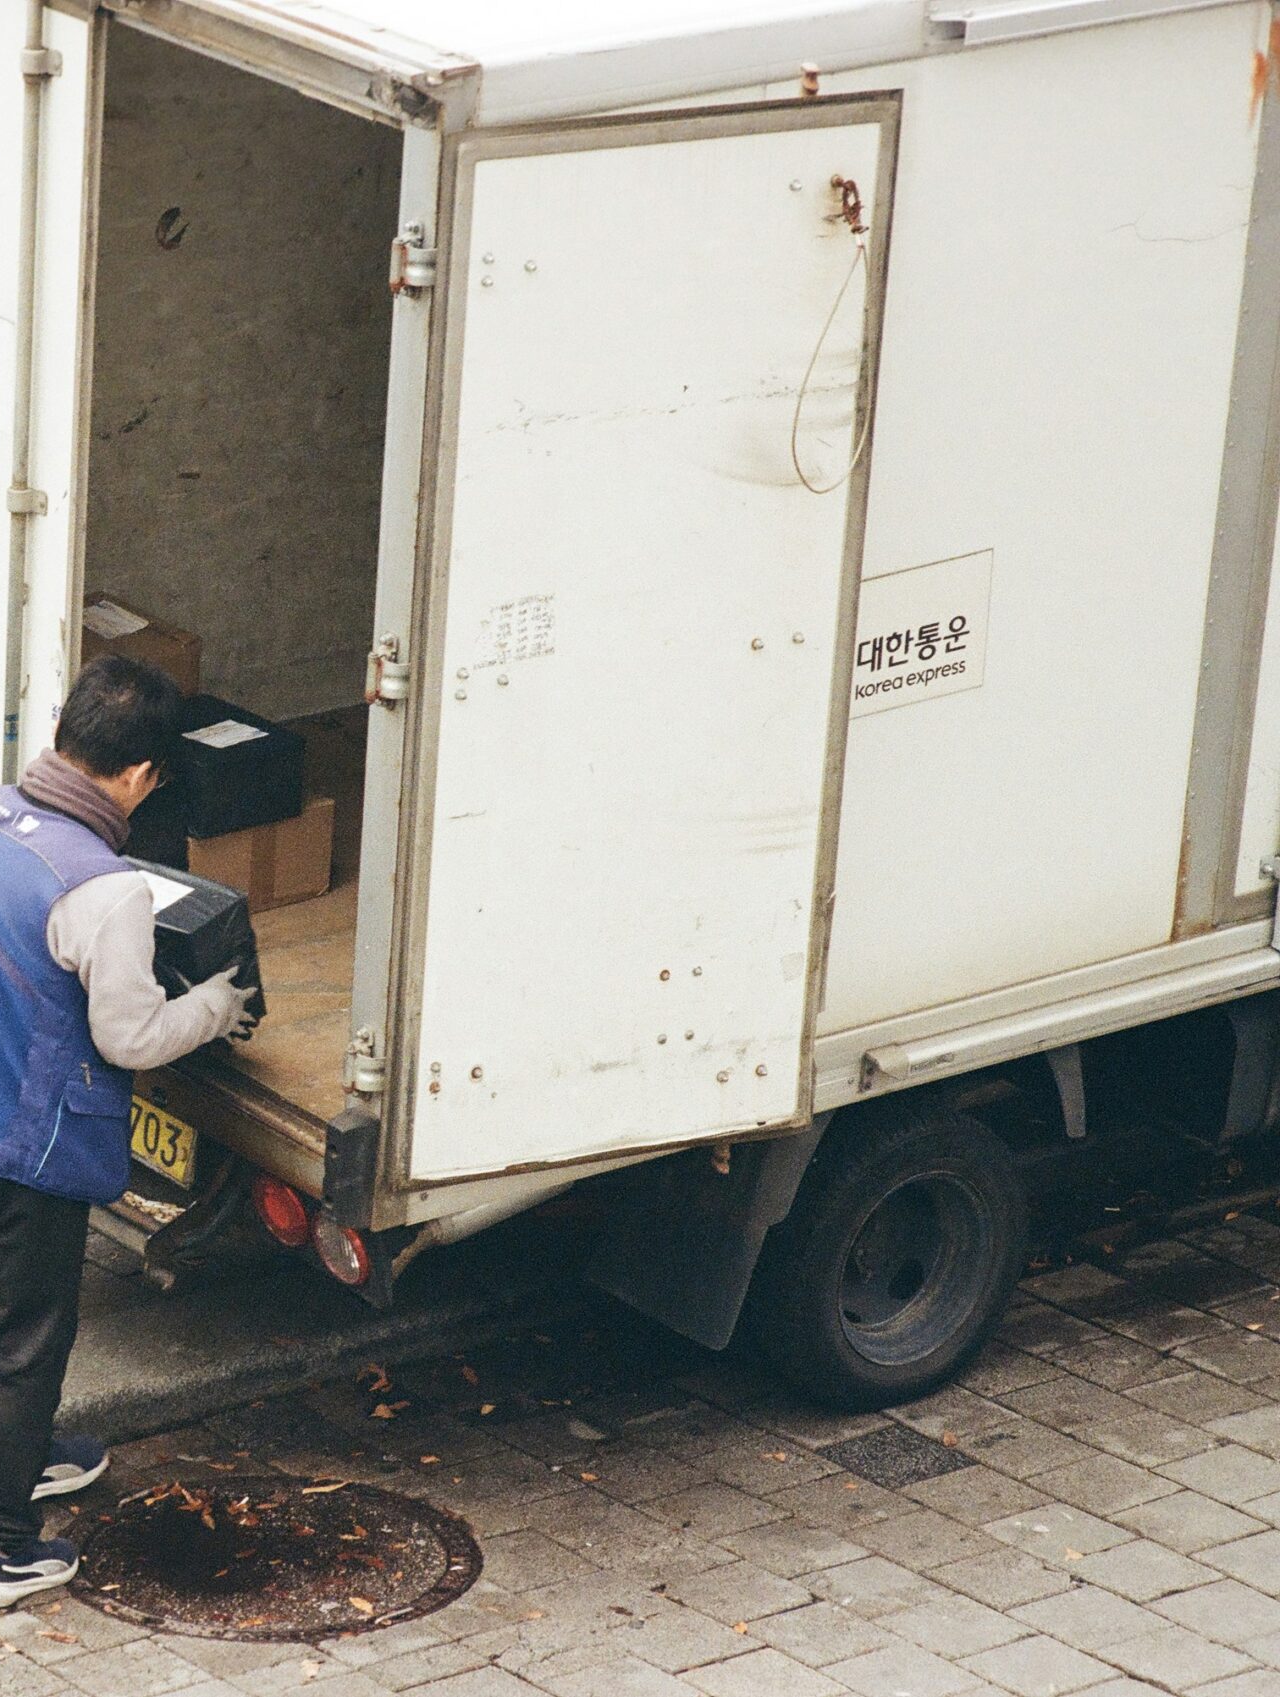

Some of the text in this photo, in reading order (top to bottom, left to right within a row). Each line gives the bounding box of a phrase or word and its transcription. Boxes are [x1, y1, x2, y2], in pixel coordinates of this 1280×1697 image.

[856, 615, 970, 673] 대한통운
[855, 660, 966, 700] korea express
